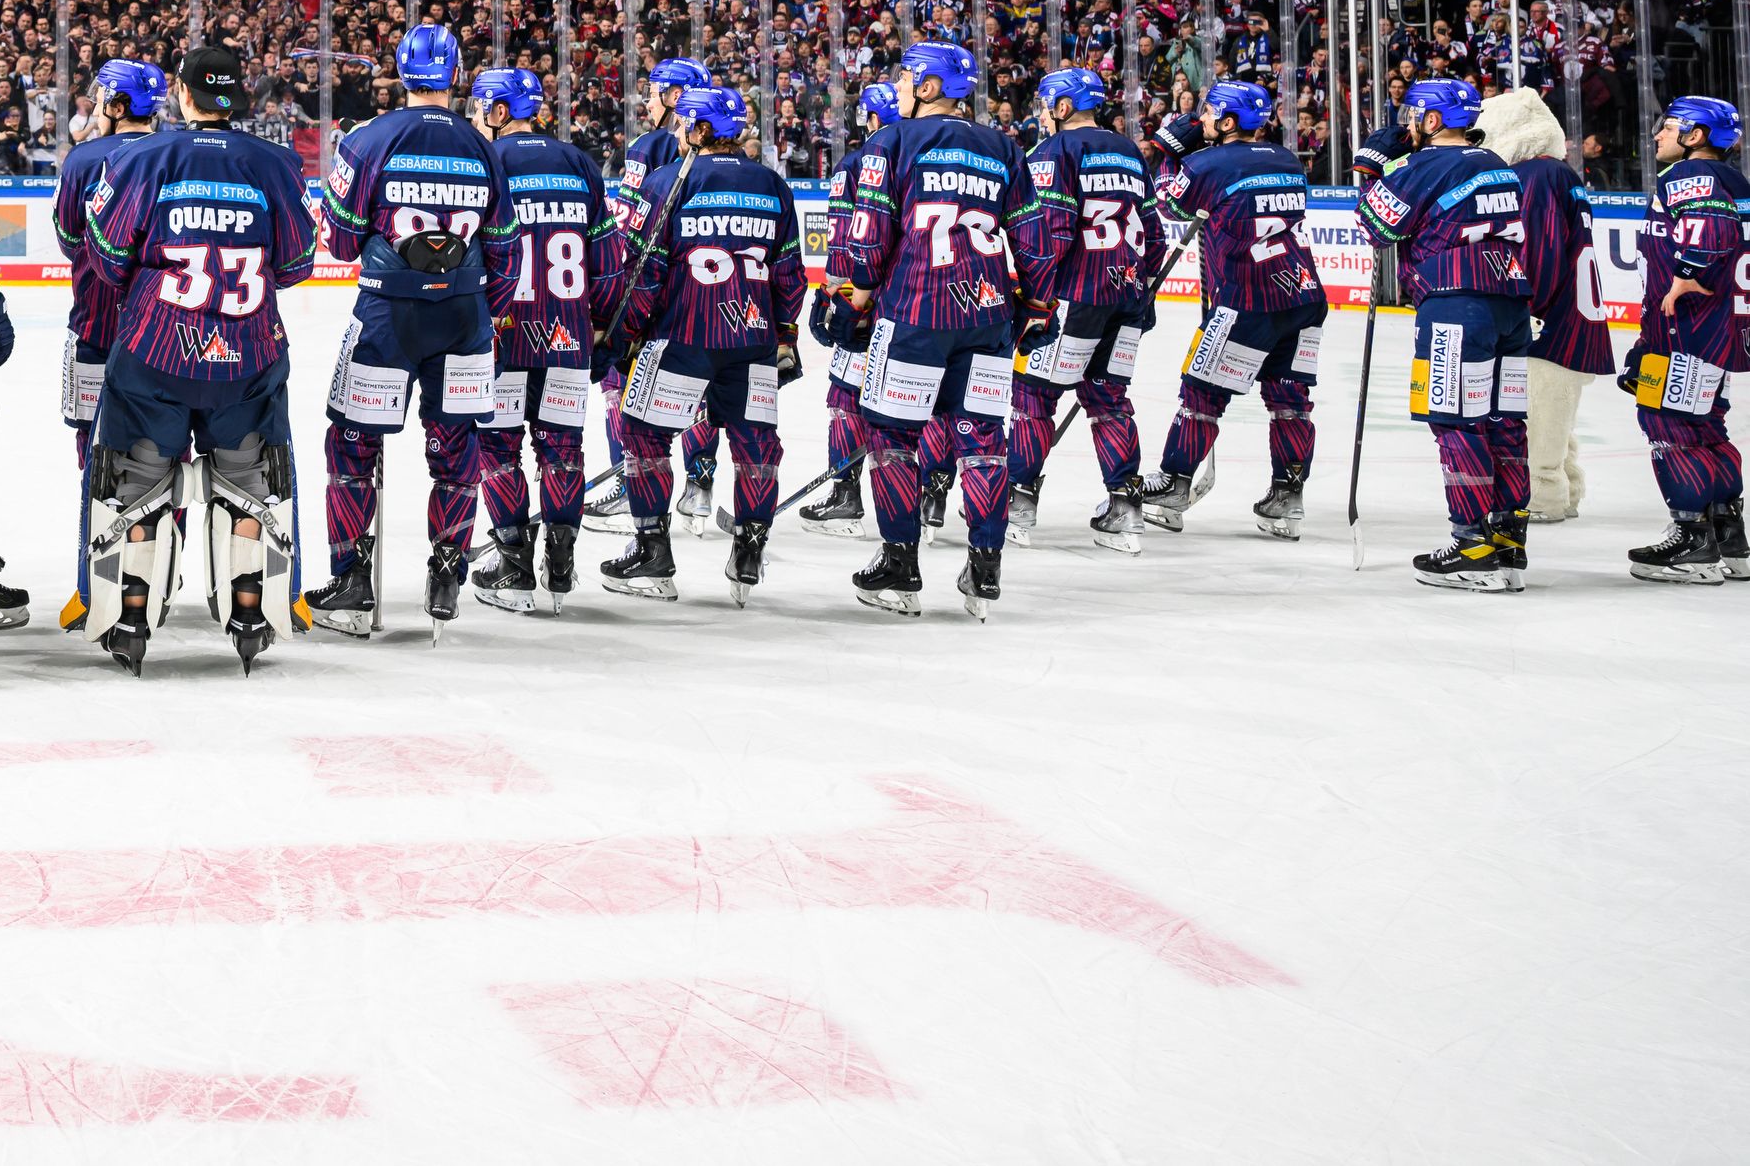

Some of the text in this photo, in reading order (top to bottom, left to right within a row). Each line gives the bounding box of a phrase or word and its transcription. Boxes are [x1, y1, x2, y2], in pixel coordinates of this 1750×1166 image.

[434, 56, 445, 65] 82
[193, 137, 227, 148] structure
[391, 156, 443, 170] EISBÄREN
[1452, 172, 1494, 200] EISBÄREN
[1669, 177, 1713, 193] LIQUI
[385, 181, 490, 208] GRENIER
[689, 193, 774, 208] EISBÄREN STROM
[1255, 192, 1306, 213] FIORE
[1375, 182, 1409, 214] LIQUI
[1589, 195, 1647, 206] GASAG
[1668, 186, 1711, 203] MOLY
[1368, 192, 1400, 223] MOLY
[169, 206, 254, 235] QUAPP
[1672, 218, 1705, 245] 97
[513, 230, 586, 302] 18
[157, 243, 266, 318] 33
[1193, 310, 1226, 372] CONTIPARK
[862, 323, 885, 401] CONTIPARK
[1432, 329, 1447, 405] CONTIPARK
[1448, 330, 1459, 399] InterparkingGroup
[354, 380, 401, 390] SPORTMETROPOLE
[449, 386, 478, 394] BERLIN
[890, 377, 936, 388] SPORTMETROPOLE
[887, 389, 917, 402] BERLIN
[972, 386, 1000, 396] BERLIN
[352, 394, 381, 405] BERLIN
[546, 396, 575, 407] BERLIN
[654, 400, 680, 411] BERLIN
[752, 395, 774, 404] BERLIN
[806, 467, 836, 493] ALPHA
